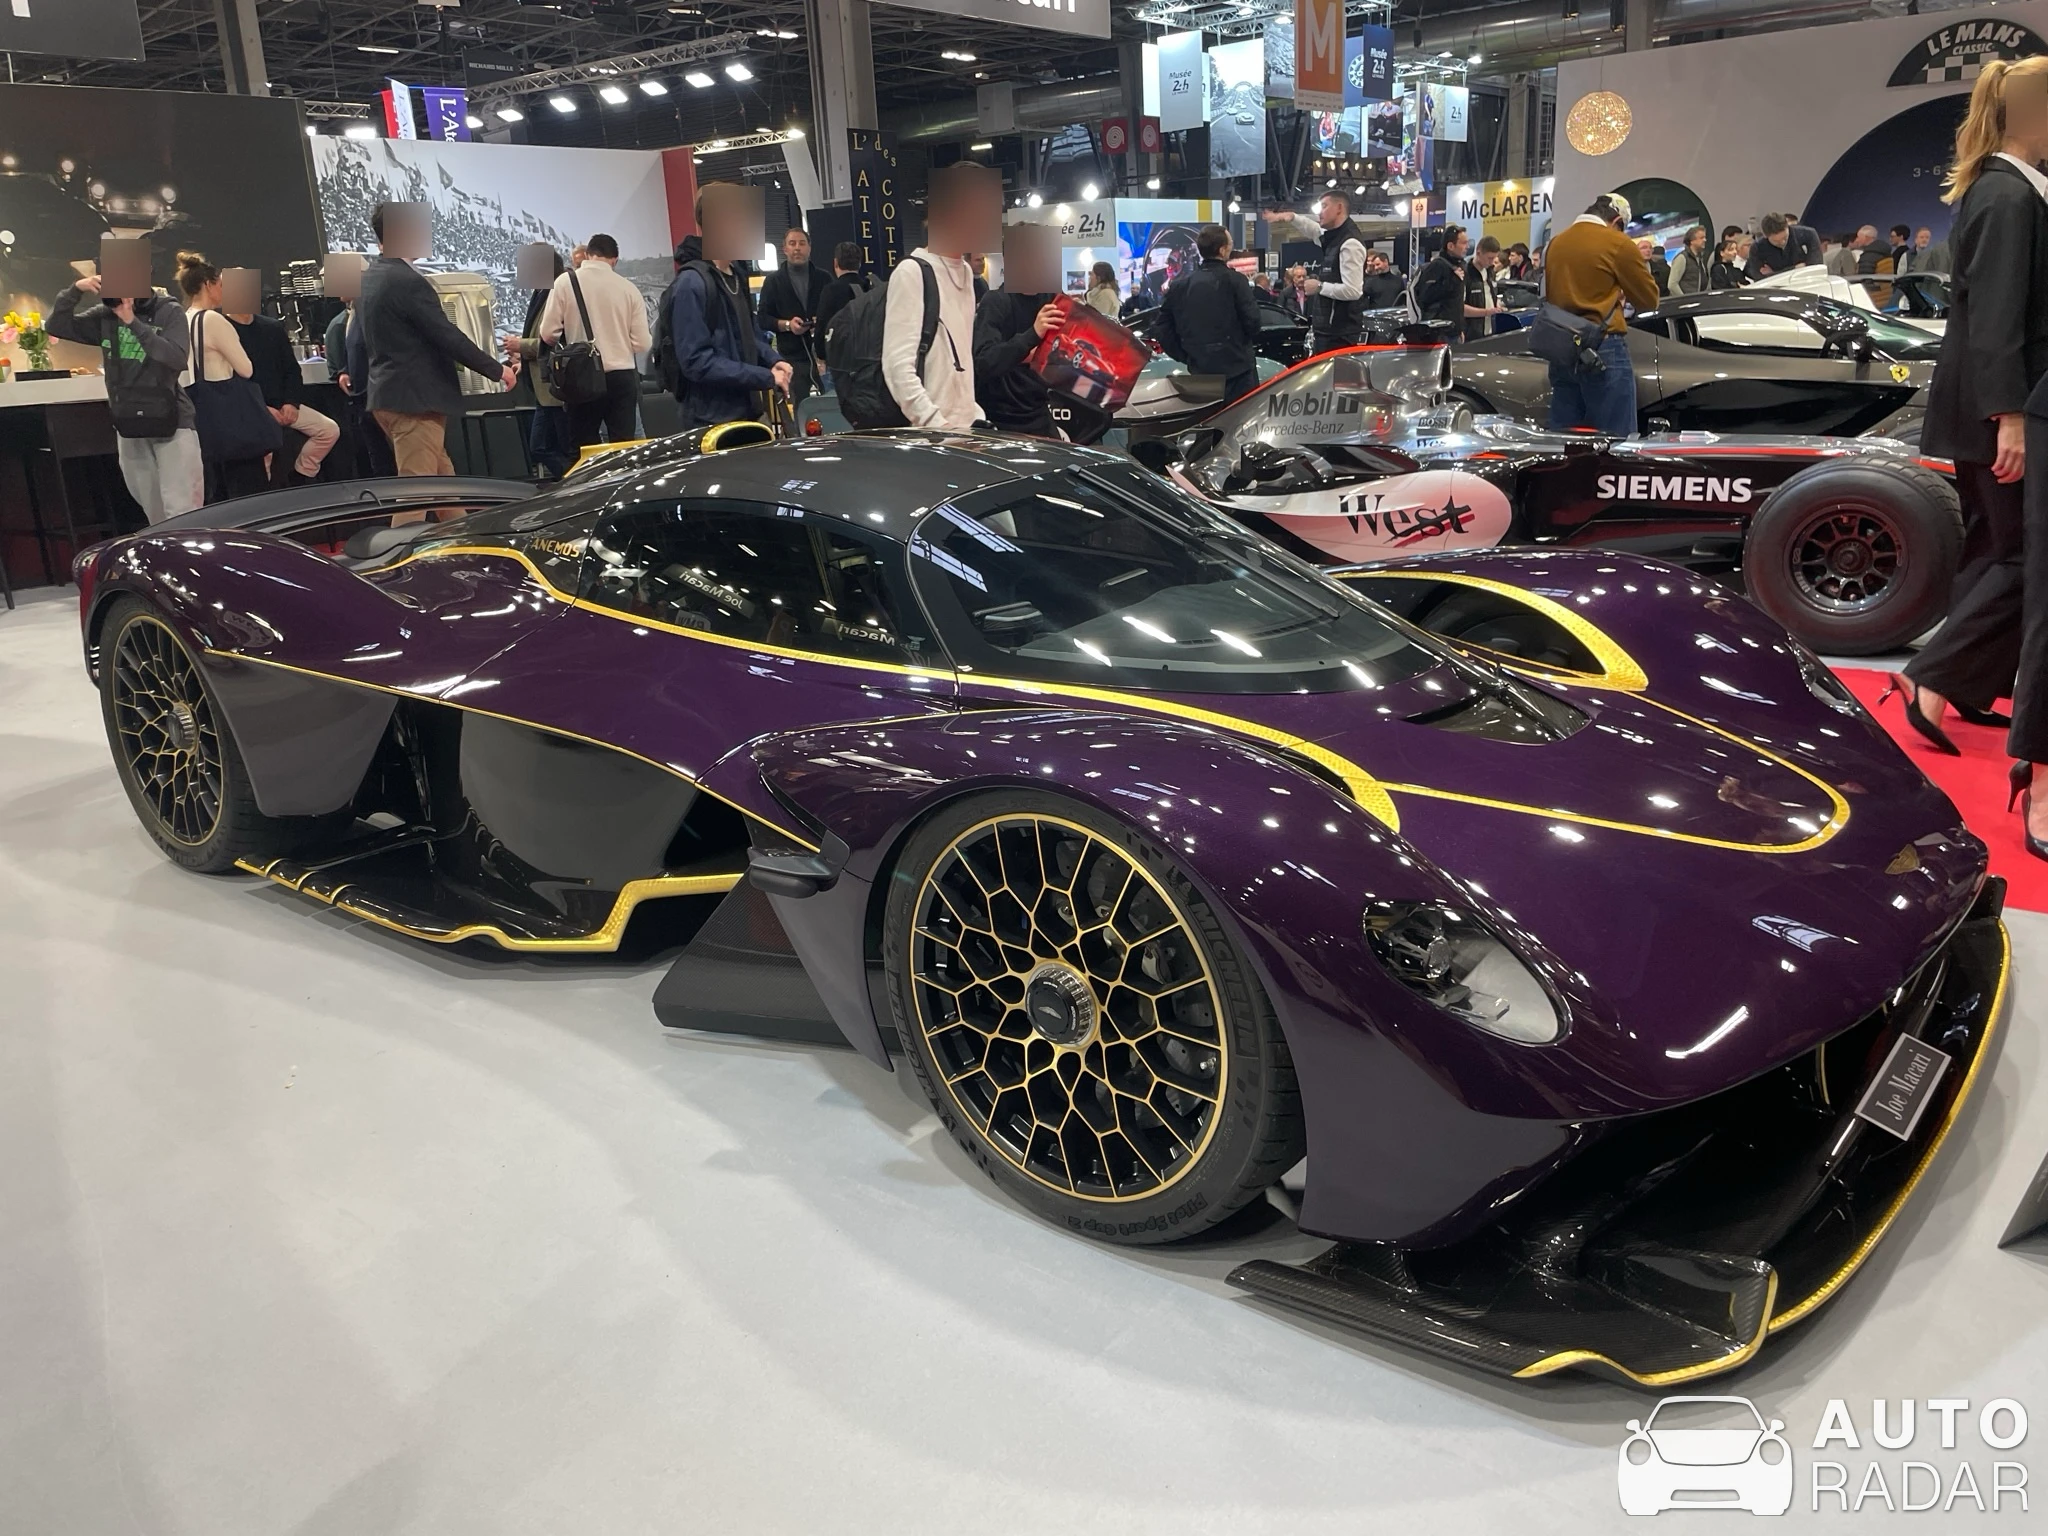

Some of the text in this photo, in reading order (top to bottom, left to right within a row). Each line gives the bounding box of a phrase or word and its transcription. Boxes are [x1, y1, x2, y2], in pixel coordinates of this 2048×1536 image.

[1305, 0, 1336, 75] M
[1927, 22, 2026, 56] LE MANS
[1952, 42, 1993, 56] CLASSIC
[468, 62, 514, 72] RICHARD MILLE
[1169, 69, 1192, 79] Musée
[1462, 192, 1553, 220] McLAREN
[1267, 391, 1333, 418] Mobil
[1254, 420, 1344, 437] Mercedes-Benz
[1420, 417, 1447, 426] BOSS
[1596, 474, 1752, 503] SIEMENS
[1338, 494, 1471, 542] West
[531, 536, 580, 558] ANEMOS
[1875, 1048, 1931, 1121] Joe Macari
